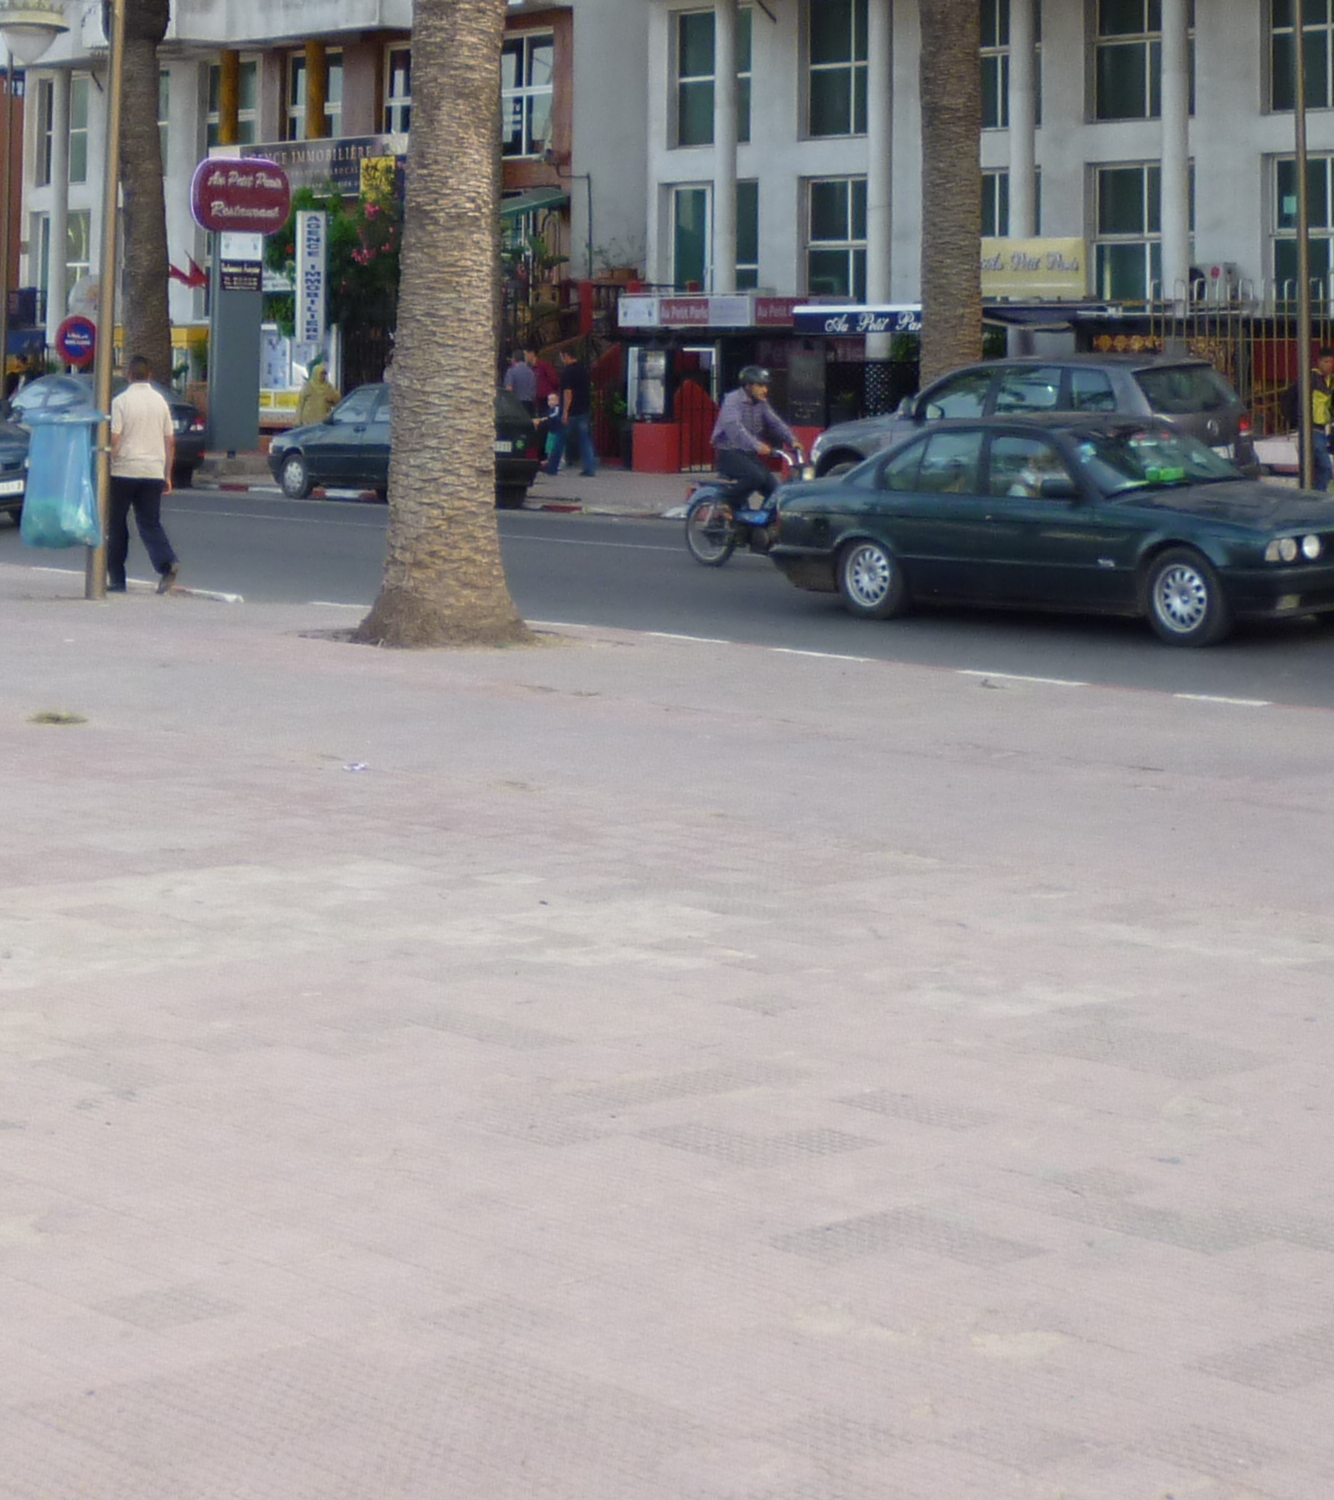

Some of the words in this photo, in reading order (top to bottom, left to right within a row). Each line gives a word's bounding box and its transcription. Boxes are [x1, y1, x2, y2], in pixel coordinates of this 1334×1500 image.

[245, 151, 287, 166] GENCE
[207, 171, 226, 186] Au
[228, 171, 254, 188] Petit
[255, 172, 283, 190] Paris
[210, 200, 280, 218] Restaurant
[306, 216, 321, 258] AGENCE
[825, 314, 849, 333] Au
[856, 312, 889, 332] Petit
[895, 311, 922, 331] Par
